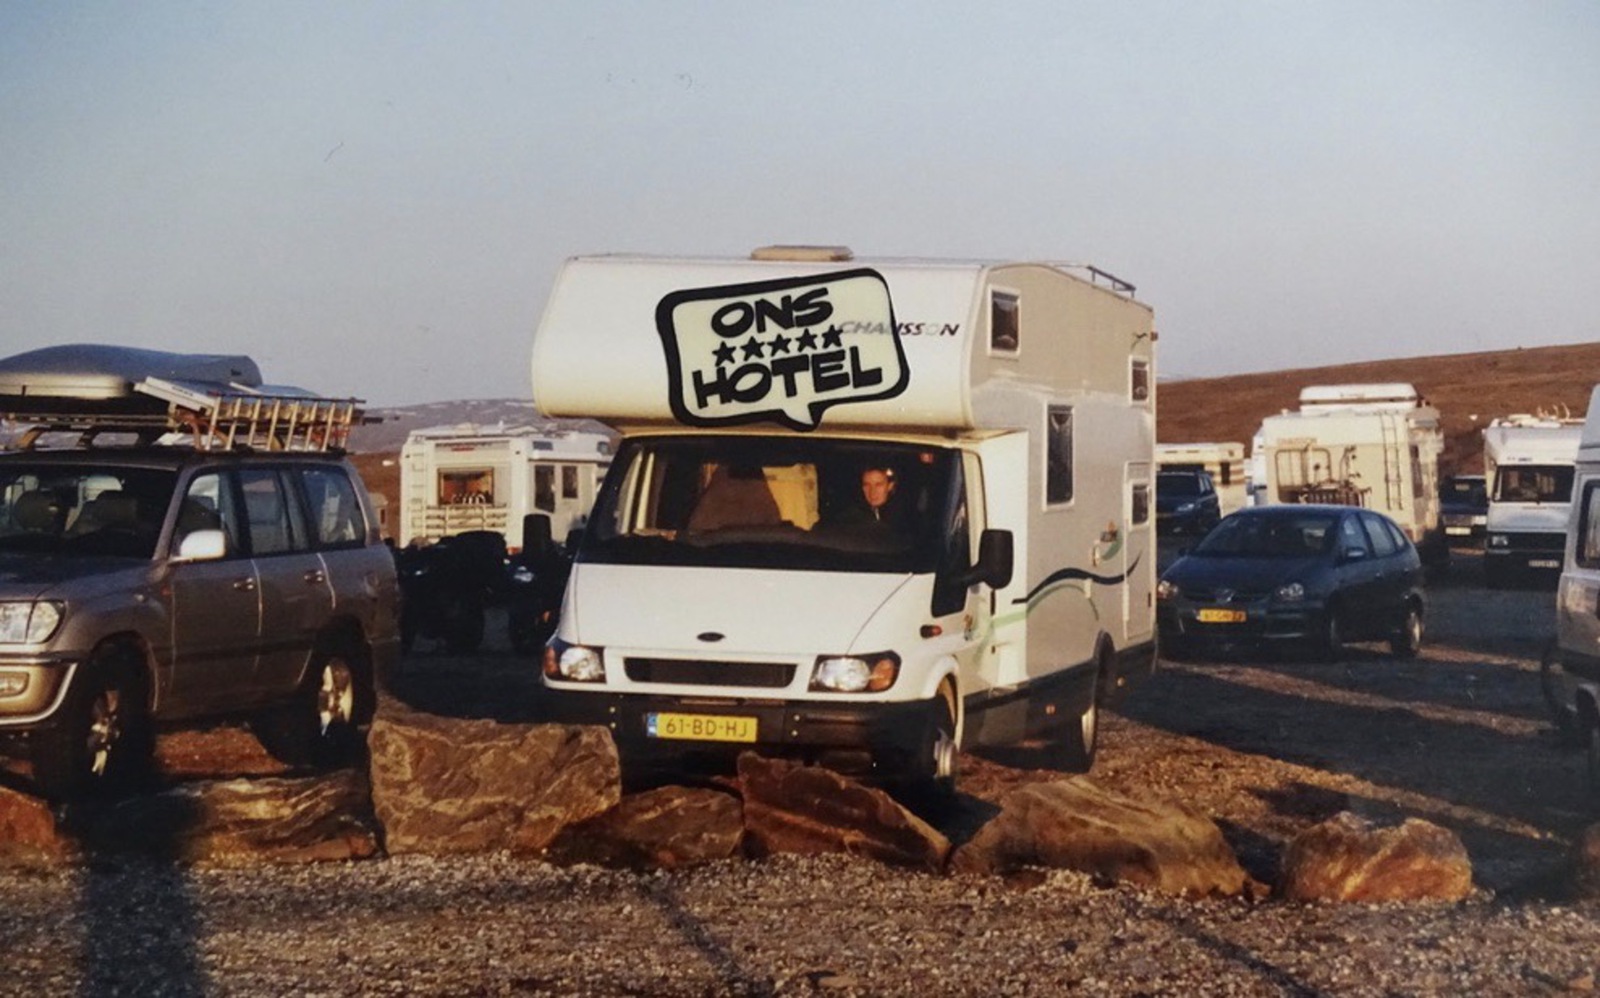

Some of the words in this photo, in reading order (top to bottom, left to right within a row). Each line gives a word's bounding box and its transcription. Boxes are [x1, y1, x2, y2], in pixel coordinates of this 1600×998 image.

[711, 288, 833, 338] ONS
[692, 347, 883, 409] HOTEL
[666, 718, 748, 737] 61-BD-HJ
